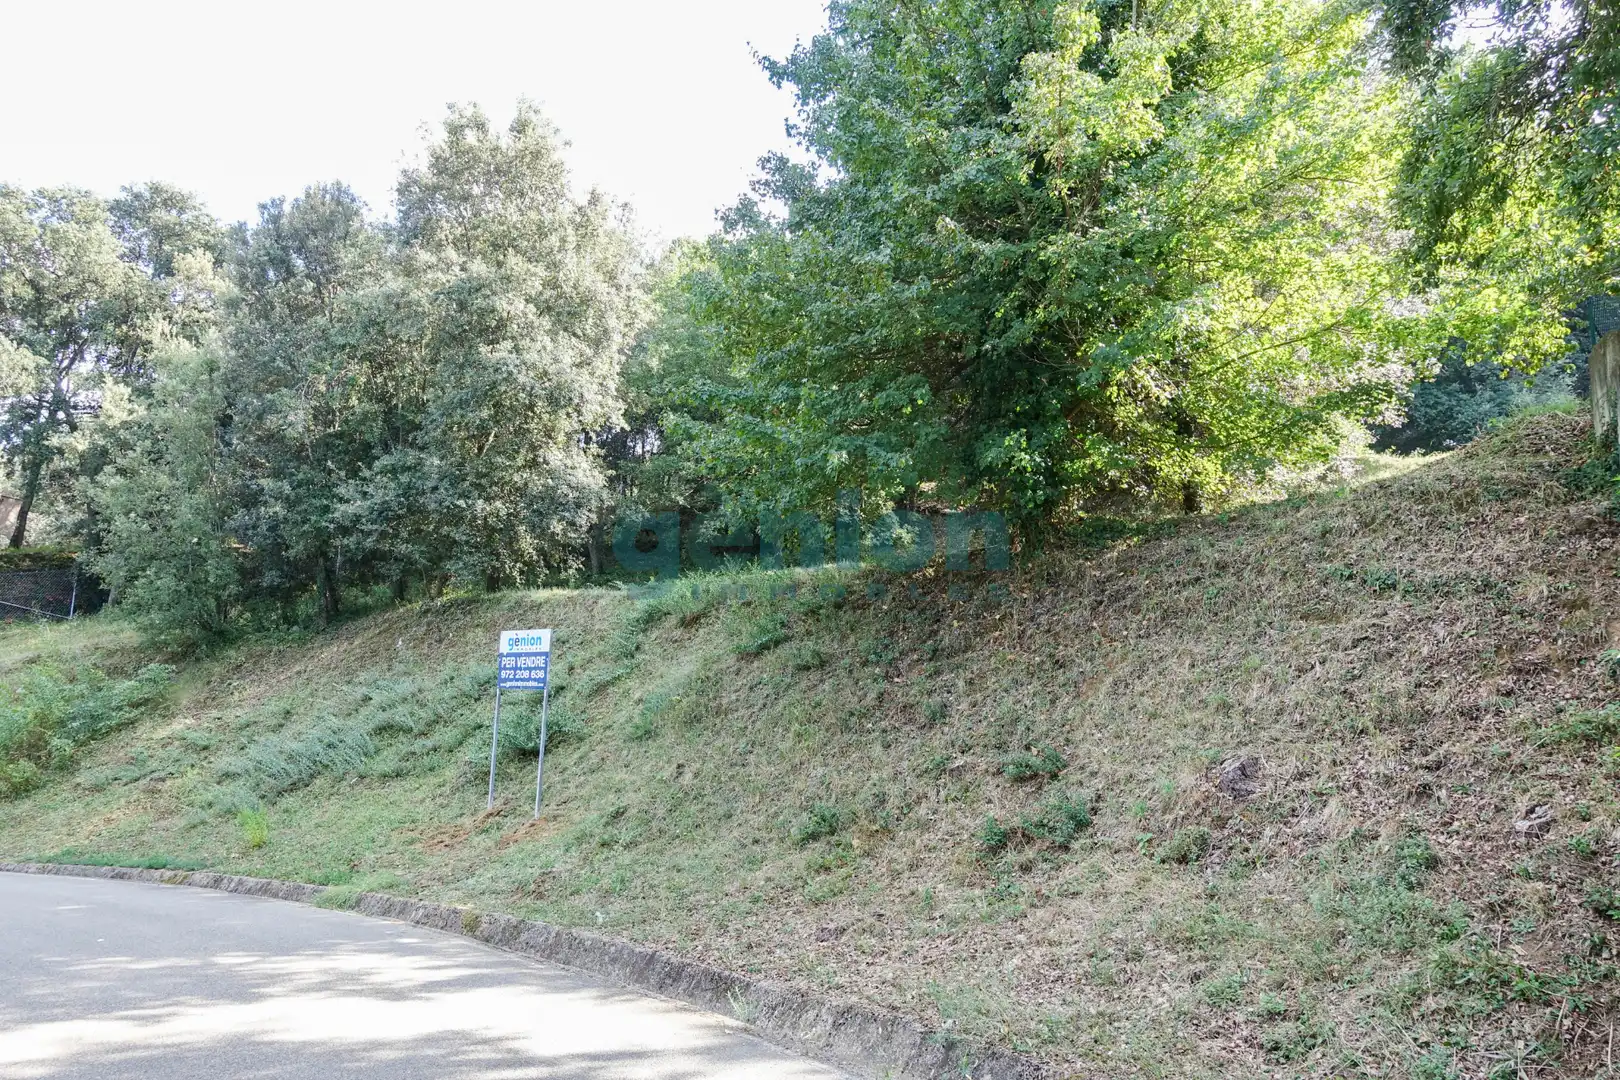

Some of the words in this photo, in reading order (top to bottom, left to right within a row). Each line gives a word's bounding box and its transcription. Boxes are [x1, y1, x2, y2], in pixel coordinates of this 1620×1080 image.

[508, 633, 542, 651] gènion
[501, 657, 515, 668] PER
[517, 656, 545, 667] VENDRE
[501, 671, 514, 679] 972
[530, 670, 544, 679] 636
